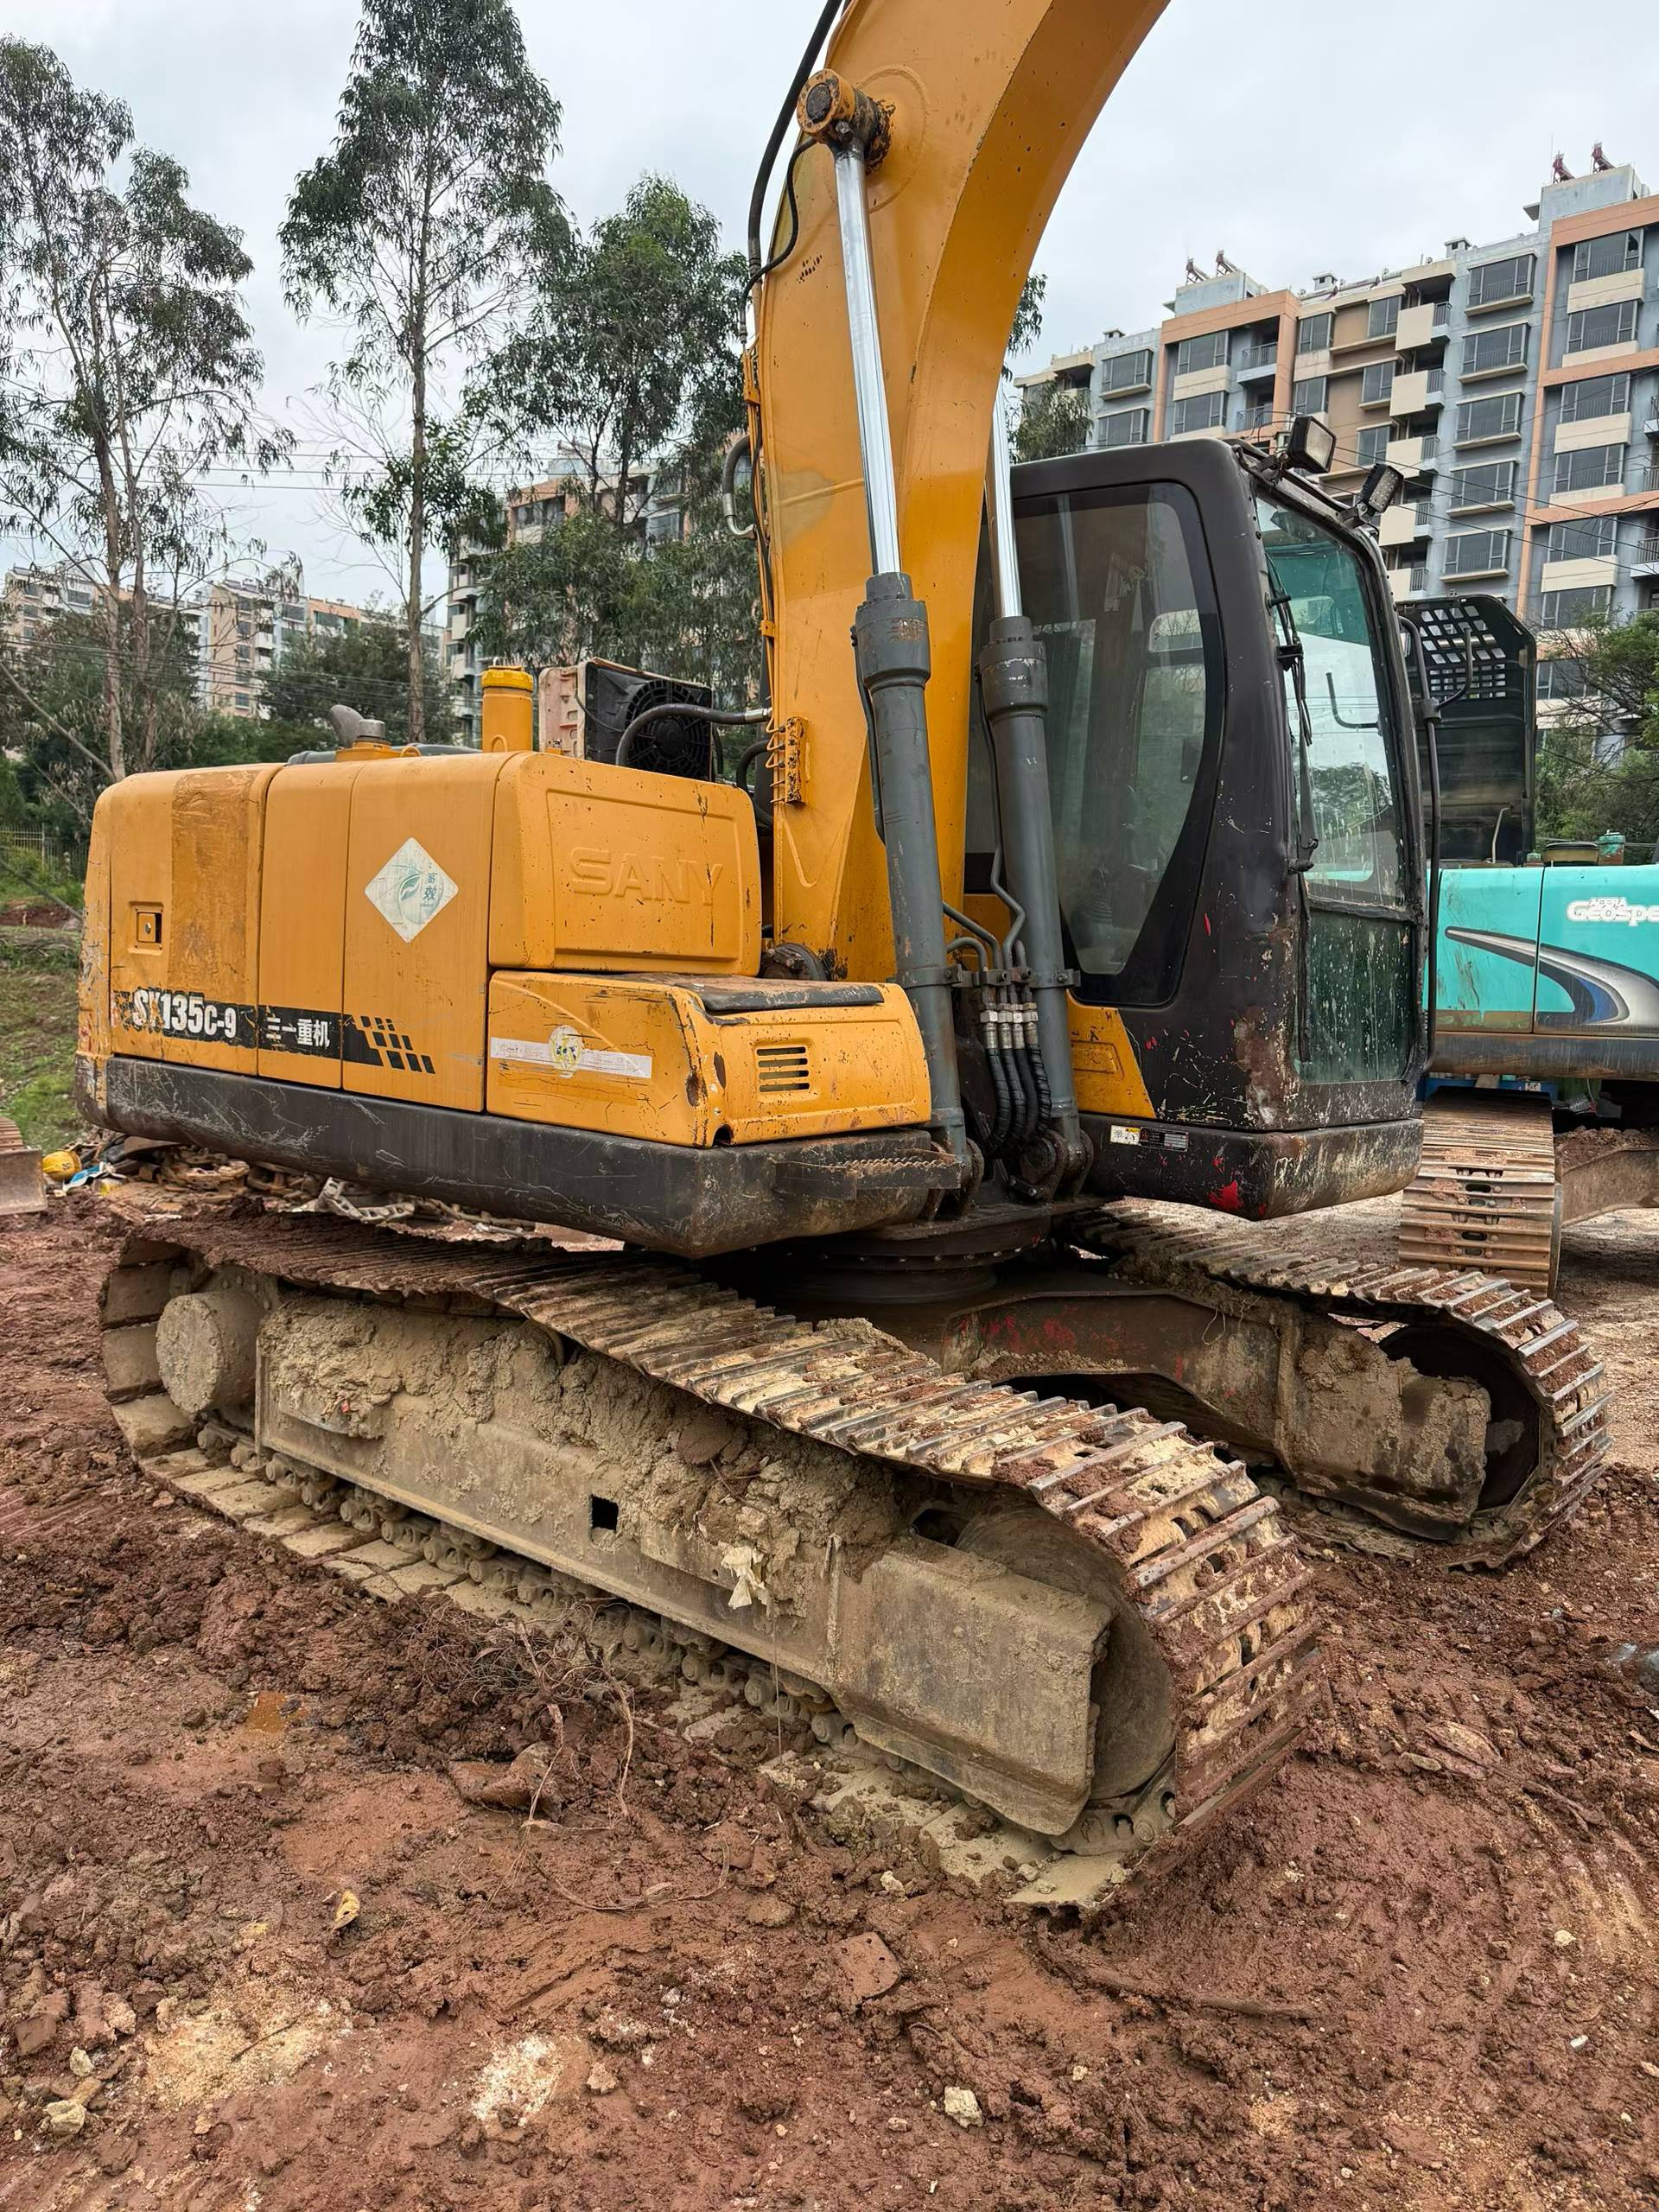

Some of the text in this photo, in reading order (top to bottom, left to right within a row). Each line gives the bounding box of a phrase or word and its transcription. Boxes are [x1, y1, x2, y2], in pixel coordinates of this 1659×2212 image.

[570, 847, 724, 906] SANY
[265, 1016, 331, 1048] 三一重机
